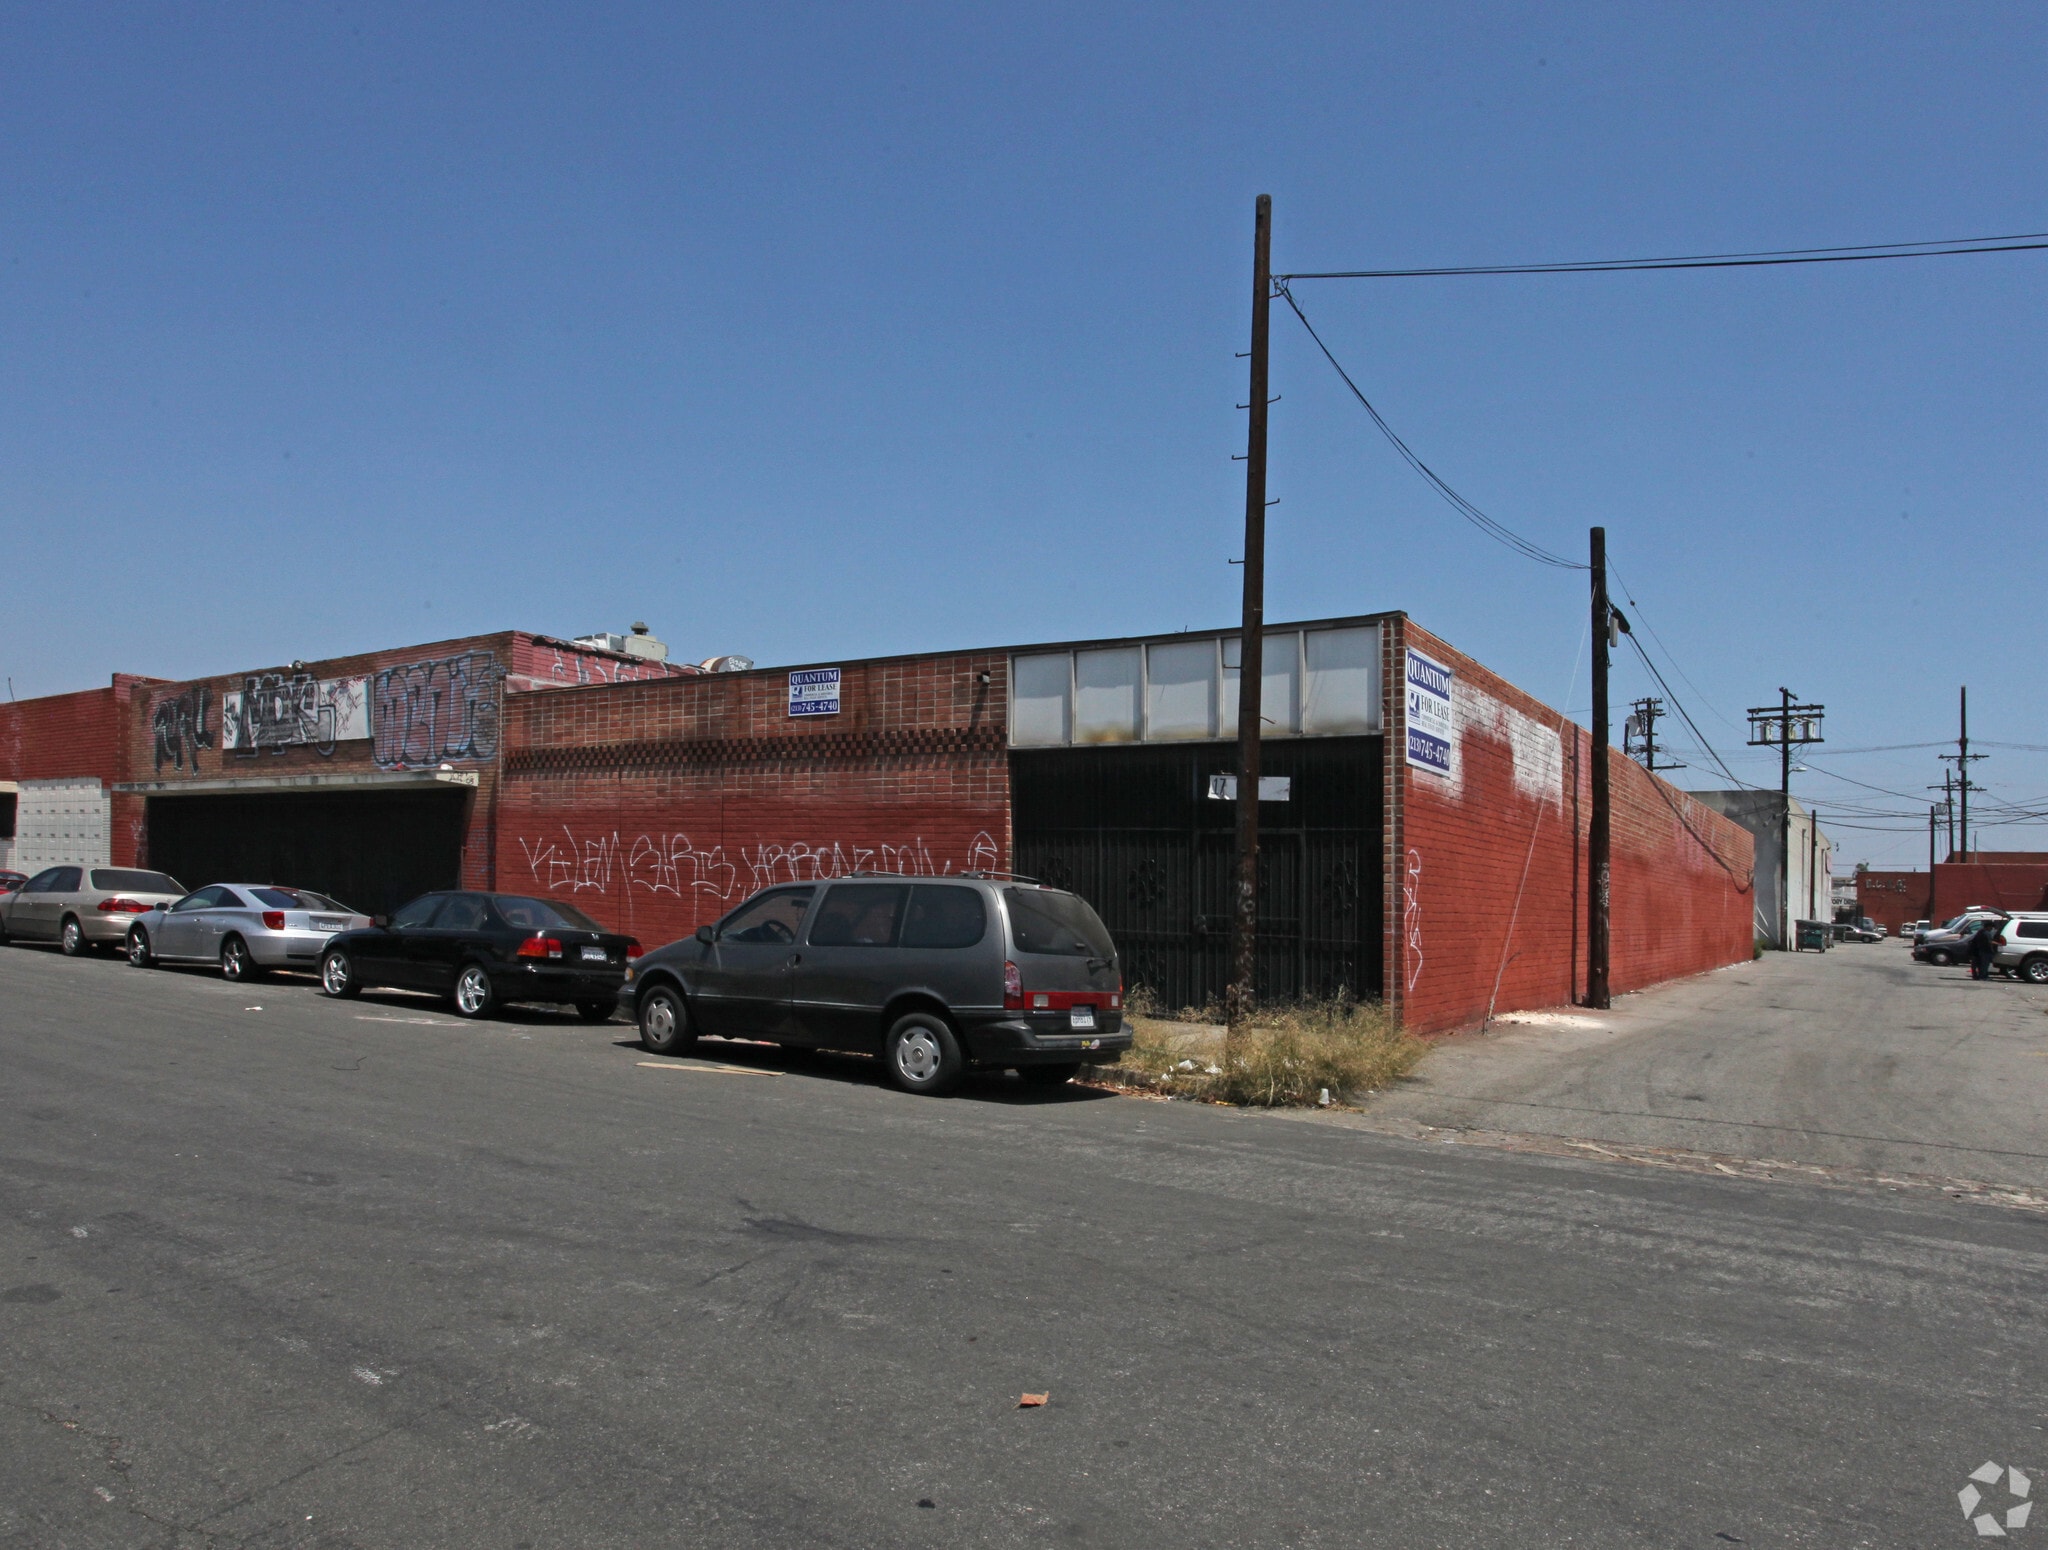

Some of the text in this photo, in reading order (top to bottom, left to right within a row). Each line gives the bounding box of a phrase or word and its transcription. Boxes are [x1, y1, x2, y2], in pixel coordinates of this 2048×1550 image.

[792, 671, 837, 684] QUANTUM
[1407, 656, 1449, 695] QUANTUM
[818, 683, 836, 691] LEASE
[1421, 694, 1450, 722] FOR LEASE
